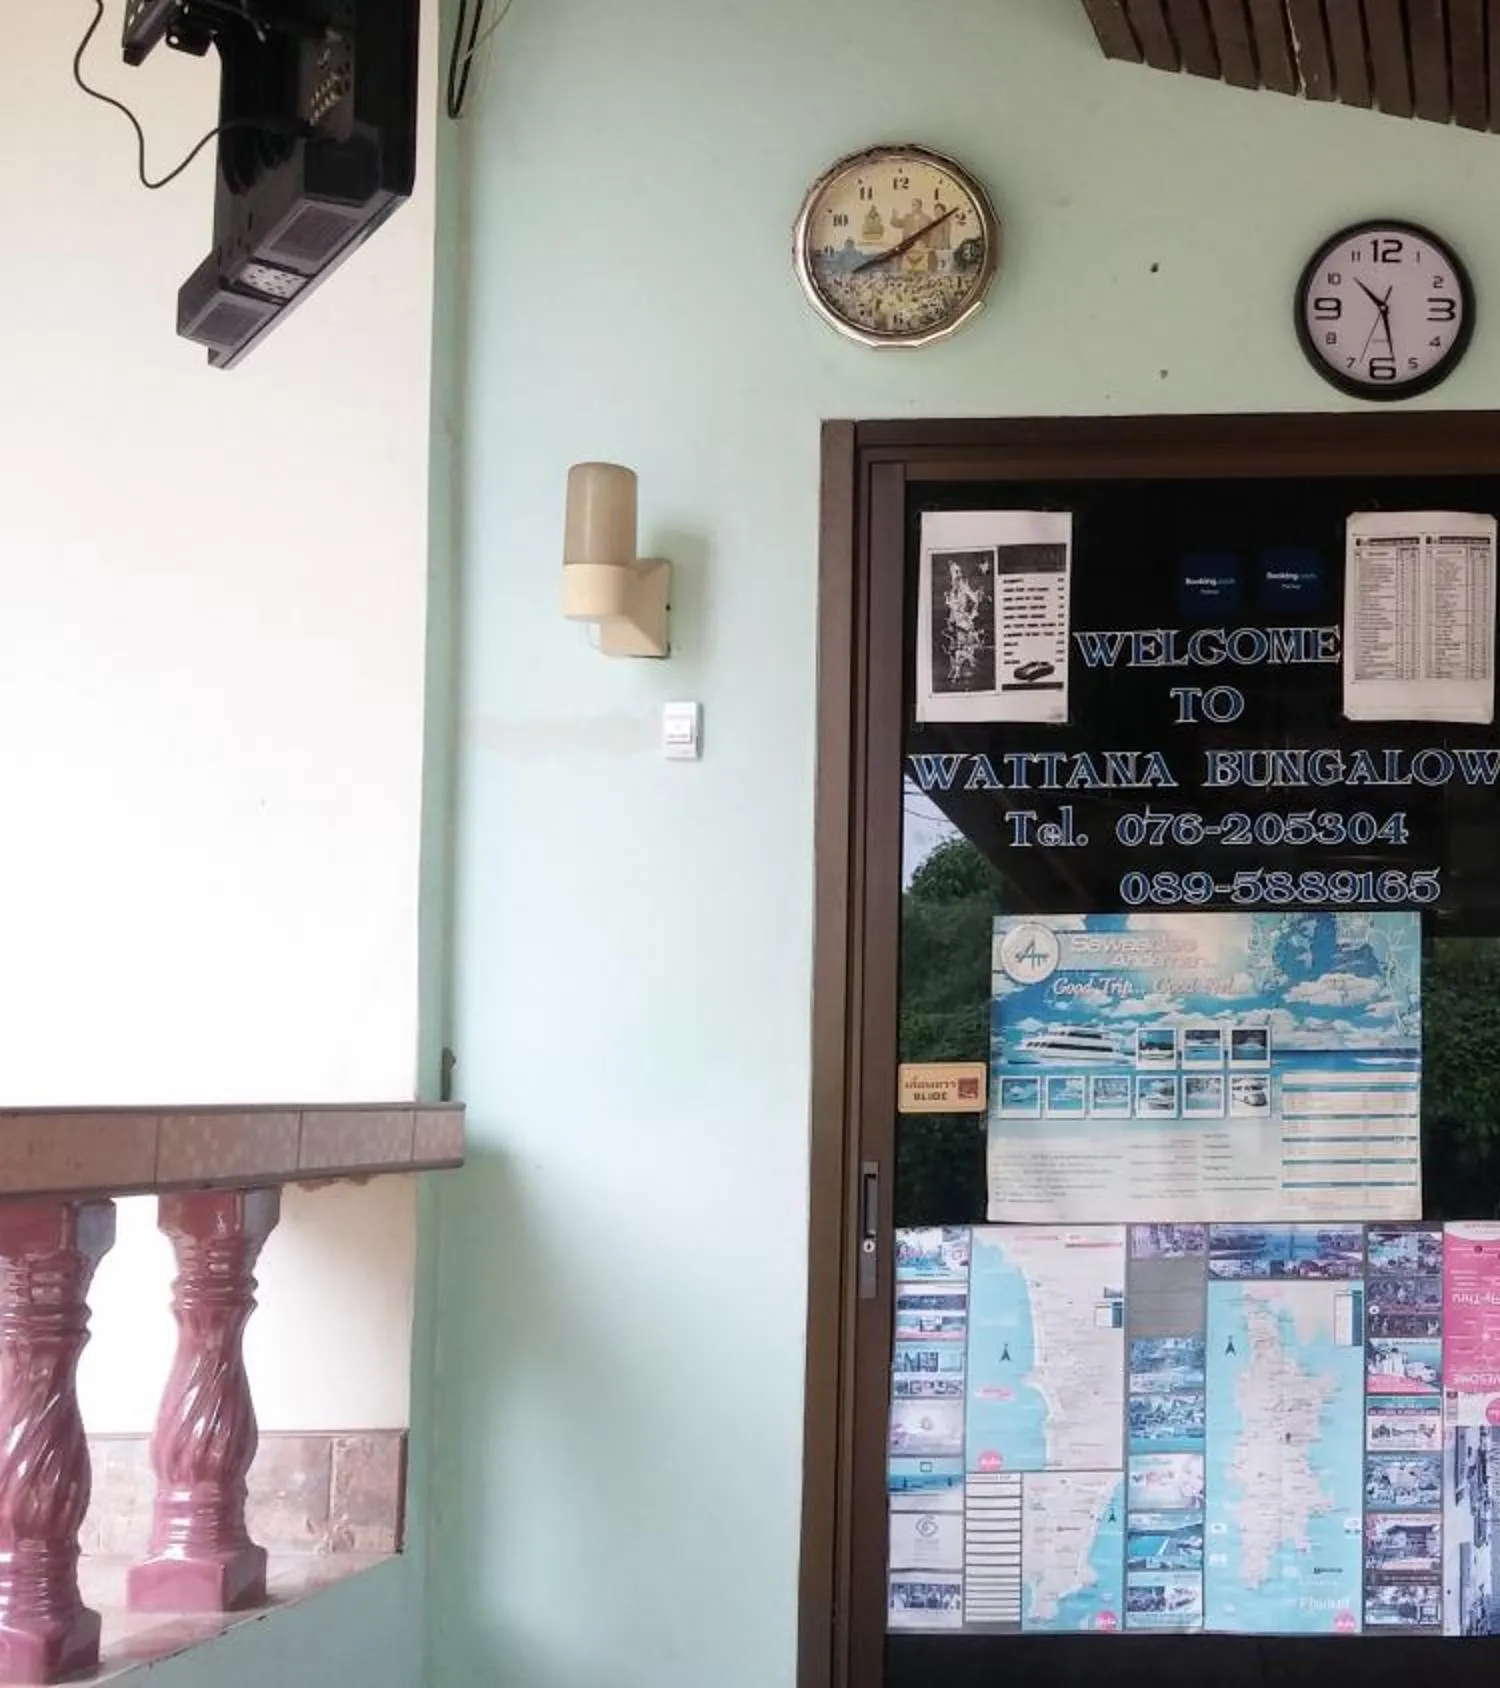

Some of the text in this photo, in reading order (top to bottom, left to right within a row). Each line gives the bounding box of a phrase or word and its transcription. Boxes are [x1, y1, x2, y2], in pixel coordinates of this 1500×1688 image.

[859, 187, 873, 200] 11
[893, 177, 909, 190] 12
[1351, 251, 1361, 263] 11
[1370, 239, 1403, 263] 12
[1327, 272, 1342, 285] 10
[1432, 275, 1444, 288] 2
[1314, 297, 1341, 320] 9
[1426, 297, 1456, 321] 3
[1325, 332, 1337, 345] 8
[1428, 336, 1441, 347] 4
[1346, 357, 1356, 369] 7
[1369, 357, 1396, 380] 6
[1407, 357, 1419, 369] 5
[1071, 624, 1342, 668] WELCOME
[1169, 685, 1245, 723] TO
[908, 751, 1180, 791] WATTANA
[1004, 804, 1410, 847] Tel. 076-205304
[1119, 867, 1442, 904] 089-5889165
[1053, 976, 1094, 996] Good
